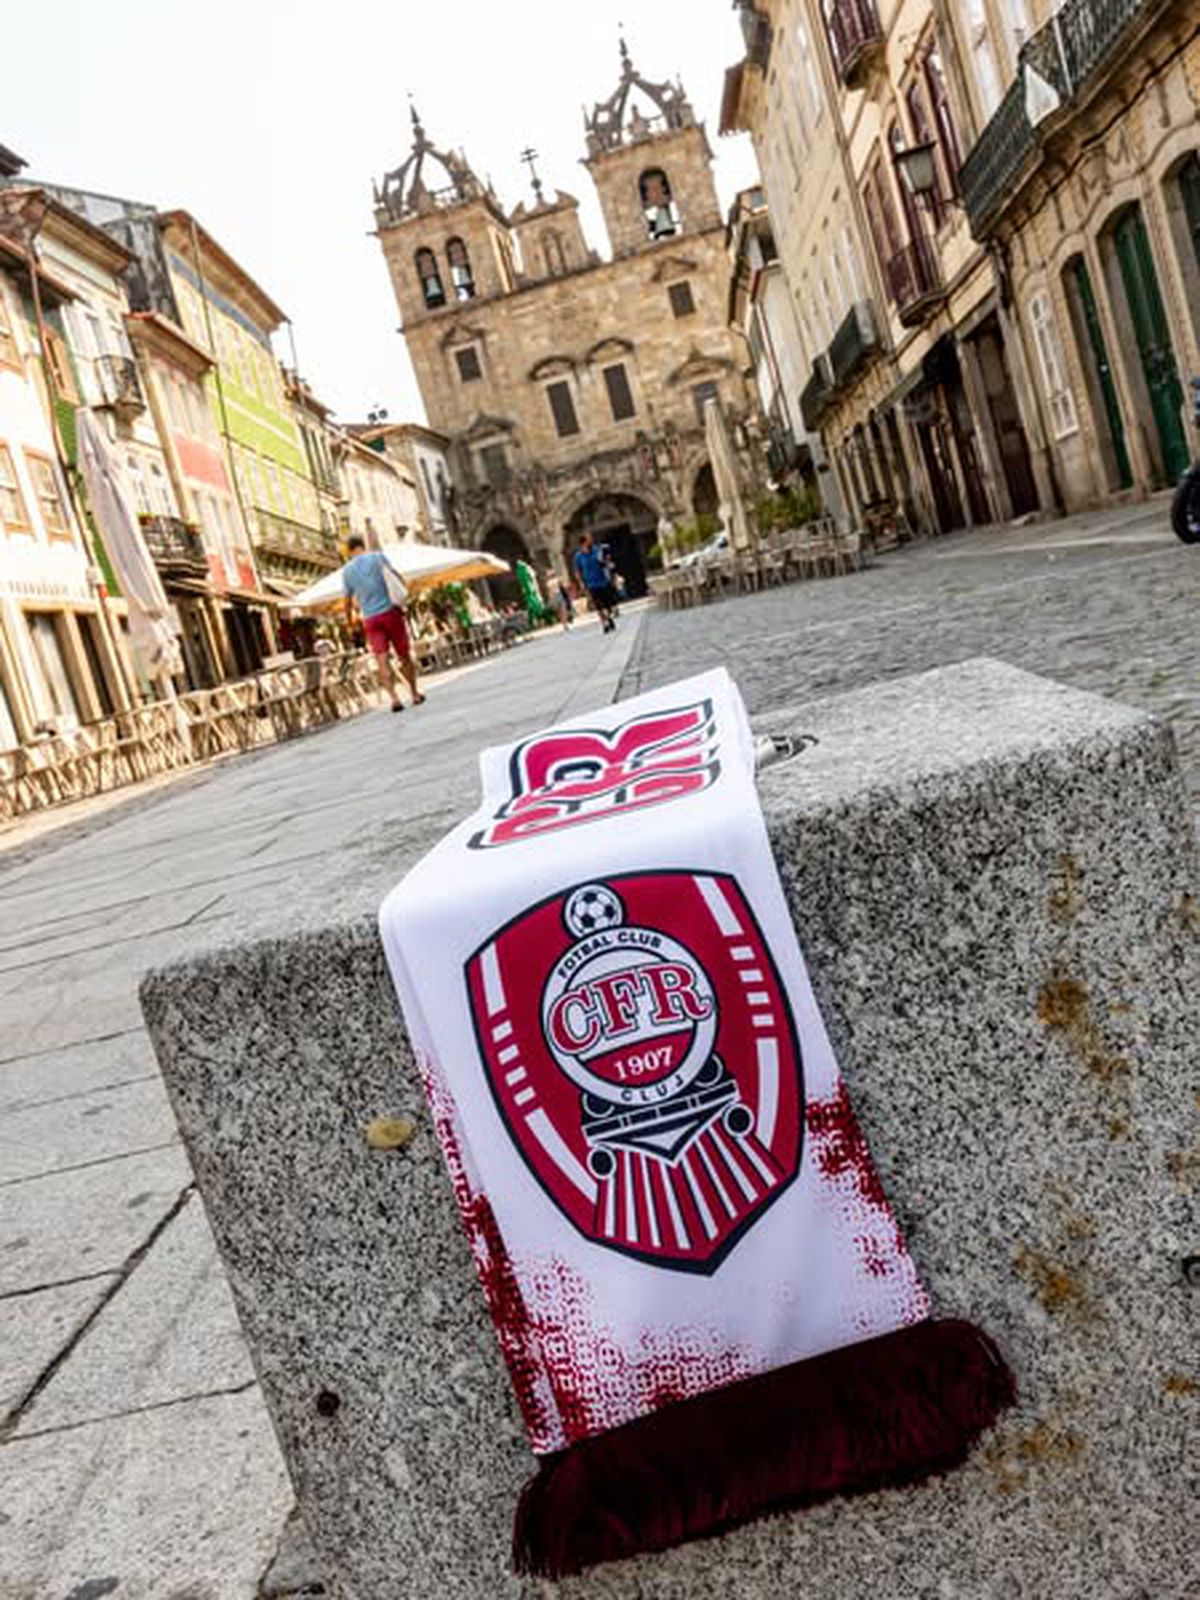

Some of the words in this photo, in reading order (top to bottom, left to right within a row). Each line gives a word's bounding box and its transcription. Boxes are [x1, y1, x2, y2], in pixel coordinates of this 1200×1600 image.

[558, 935, 612, 978] FOTBAL
[617, 932, 662, 949] CLUB
[548, 960, 713, 1056] CFR
[614, 1046, 673, 1080] 1907
[621, 1074, 684, 1101] CLUJ
